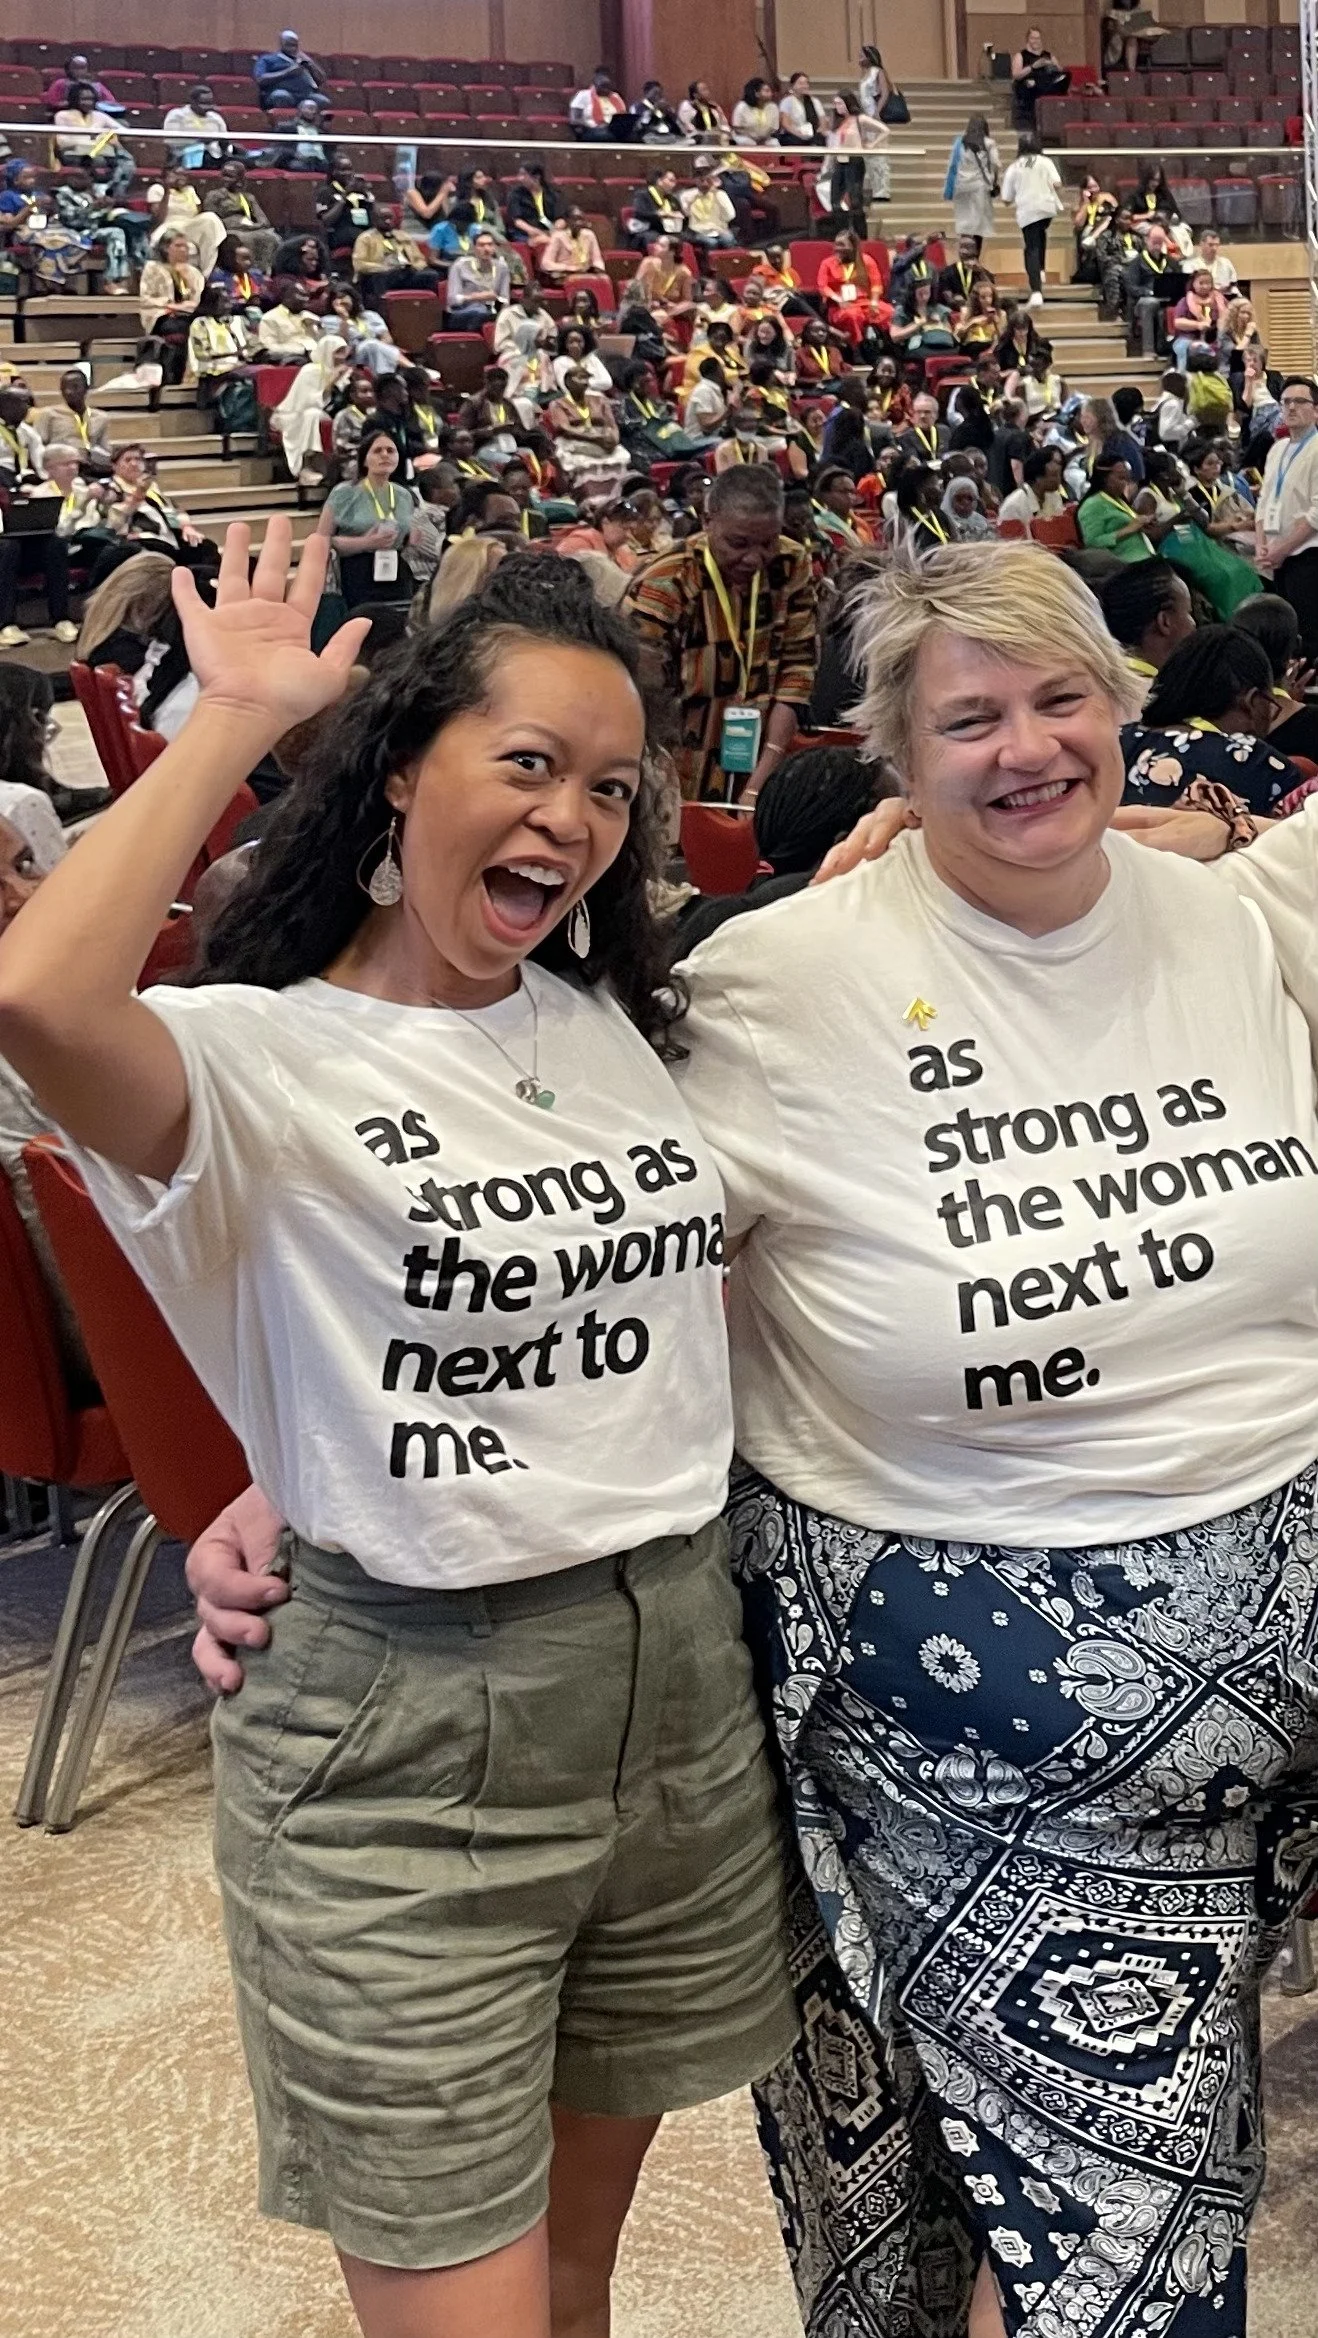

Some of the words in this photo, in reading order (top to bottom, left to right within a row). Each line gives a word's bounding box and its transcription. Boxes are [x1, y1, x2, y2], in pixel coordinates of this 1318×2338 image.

[907, 1038, 984, 1093] as
[354, 1109, 441, 1166] as
[923, 1091, 1150, 1173] strong
[1156, 1078, 1227, 1127] as
[626, 1138, 698, 1193] as
[936, 1179, 1065, 1249] the
[1072, 1135, 1318, 1220] woman
[402, 1237, 537, 1313] the
[957, 1241, 1130, 1334] next
[1139, 1228, 1214, 1289] to
[382, 1321, 562, 1397] next
[577, 1309, 649, 1380] to
[964, 1346, 1101, 1410] me.
